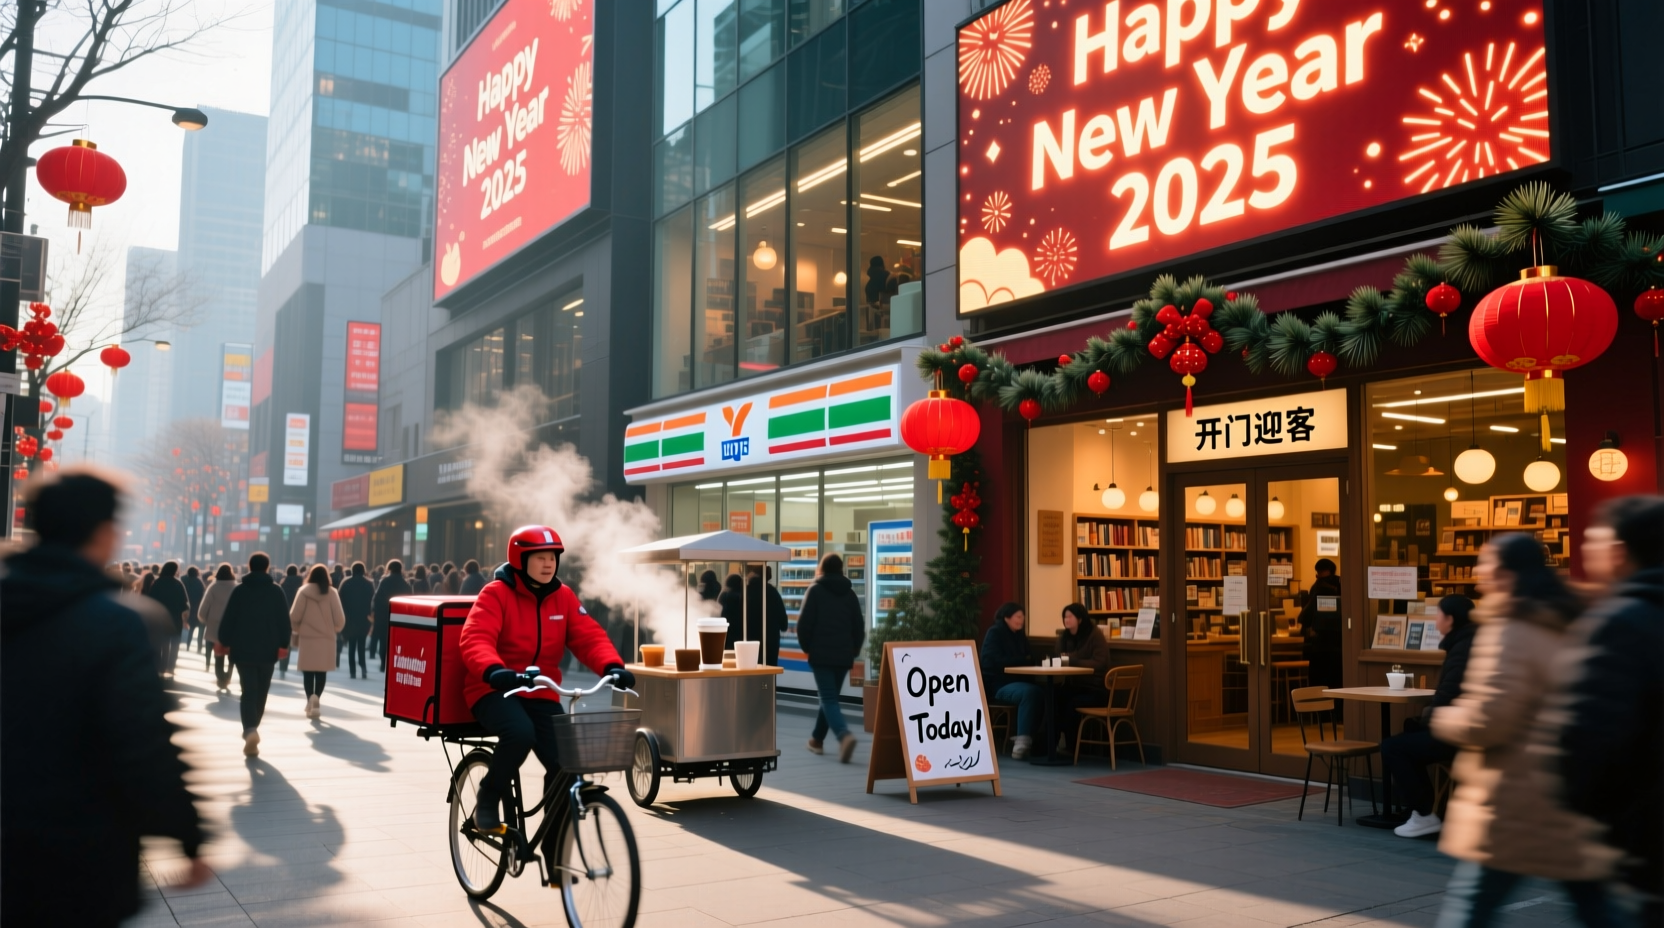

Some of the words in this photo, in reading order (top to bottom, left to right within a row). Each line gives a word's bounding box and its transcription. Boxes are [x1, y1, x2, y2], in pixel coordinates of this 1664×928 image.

[477, 37, 539, 122] Happy
[1032, 87, 1178, 191] New
[1193, 12, 1383, 130] Year
[462, 125, 503, 188] New
[504, 85, 550, 150] Year
[480, 148, 527, 221] 2025
[1109, 123, 1297, 250] 2025
[1194, 405, 1316, 451] 开门迎客
[906, 666, 970, 707] Open
[908, 708, 982, 750] Today!
